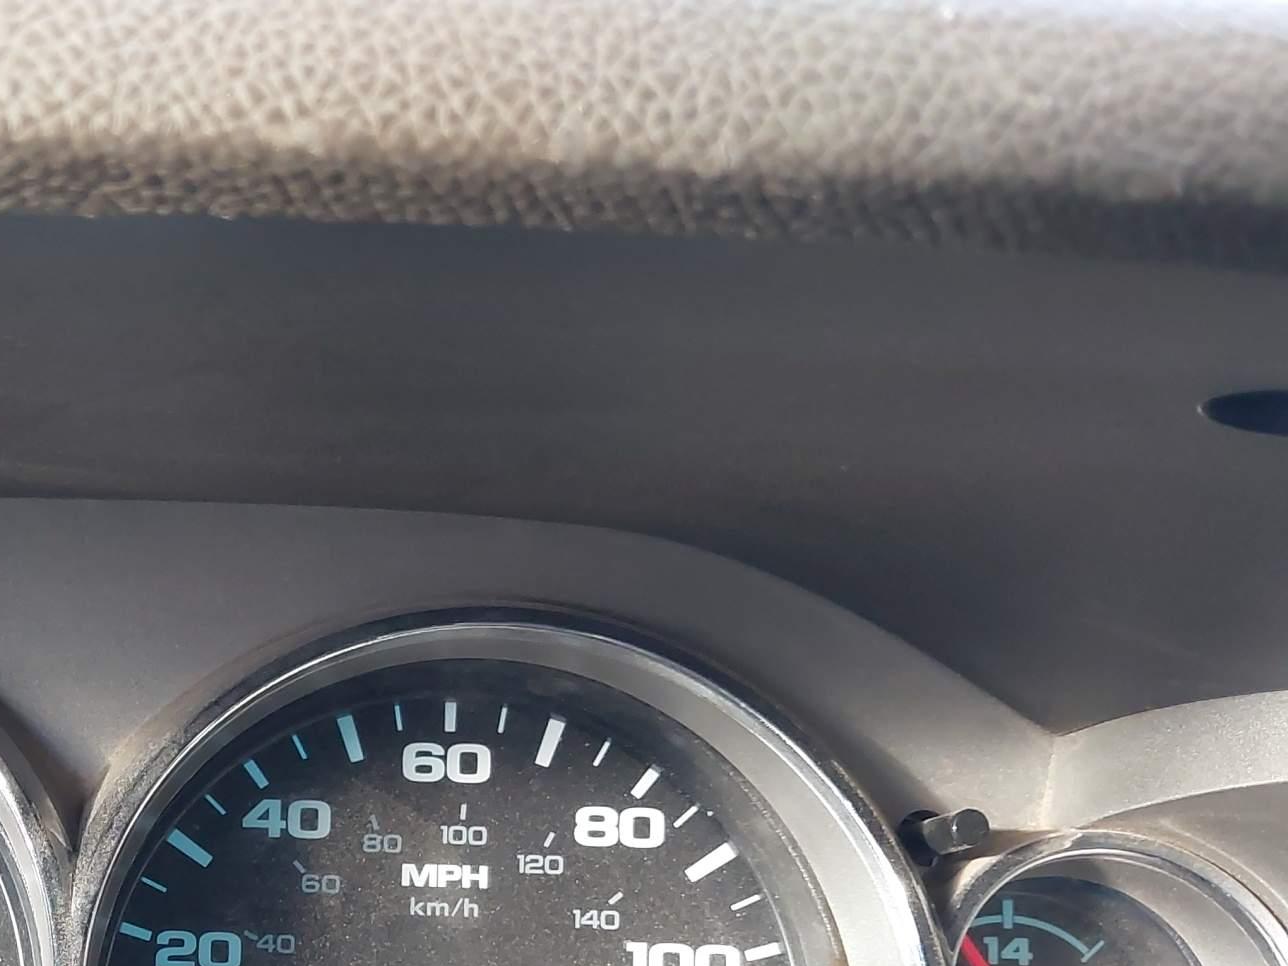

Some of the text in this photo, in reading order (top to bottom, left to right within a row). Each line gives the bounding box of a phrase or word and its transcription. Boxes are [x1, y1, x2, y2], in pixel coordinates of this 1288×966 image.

[402, 742, 492, 784] 60
[242, 799, 332, 840] 40
[574, 806, 666, 849] 80
[363, 834, 403, 854] 80
[440, 825, 488, 847] 100
[517, 854, 565, 875] 120
[302, 874, 341, 895] 60
[401, 863, 489, 890] MPH
[409, 899, 479, 918] km/h
[573, 909, 621, 930] 140
[257, 934, 296, 954] 40
[983, 936, 1033, 966] 14
